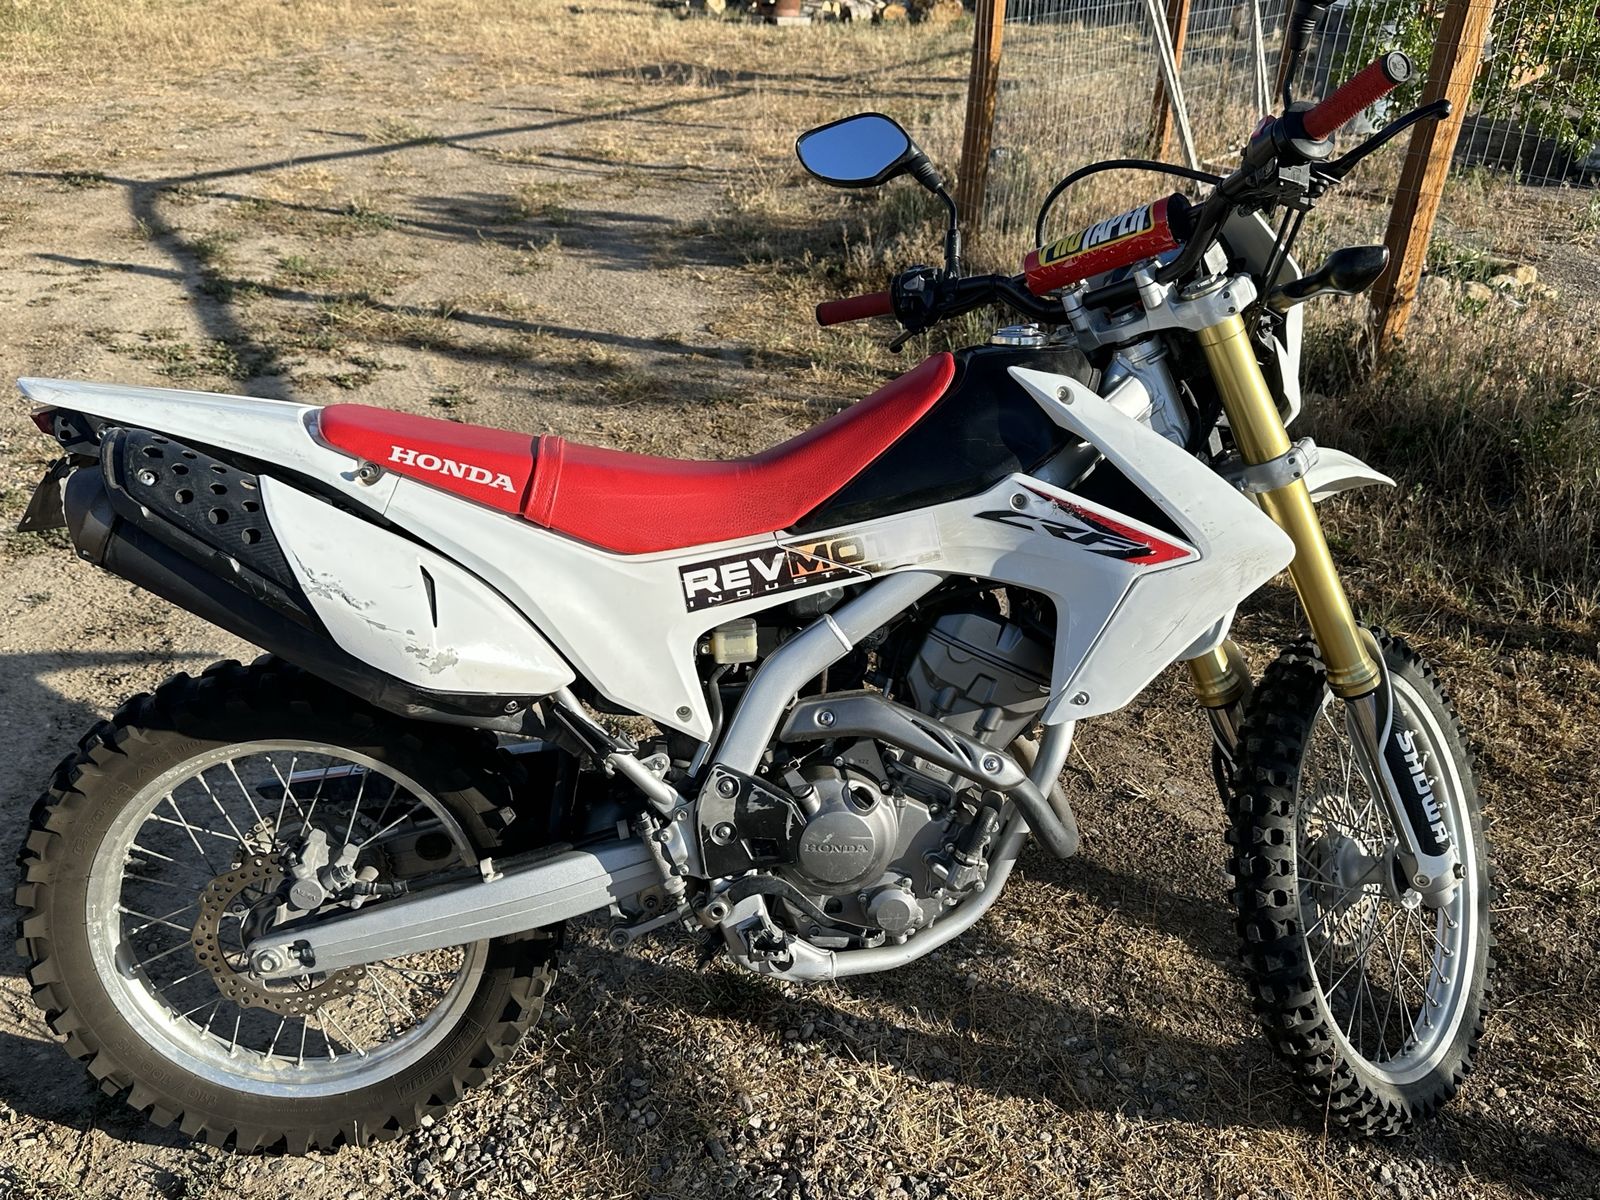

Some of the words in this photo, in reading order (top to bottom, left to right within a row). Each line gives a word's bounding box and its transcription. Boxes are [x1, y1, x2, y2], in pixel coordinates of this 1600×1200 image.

[388, 446, 517, 493] HONDA
[1395, 730, 1449, 844] SHOWA
[805, 844, 869, 854] HONDA
